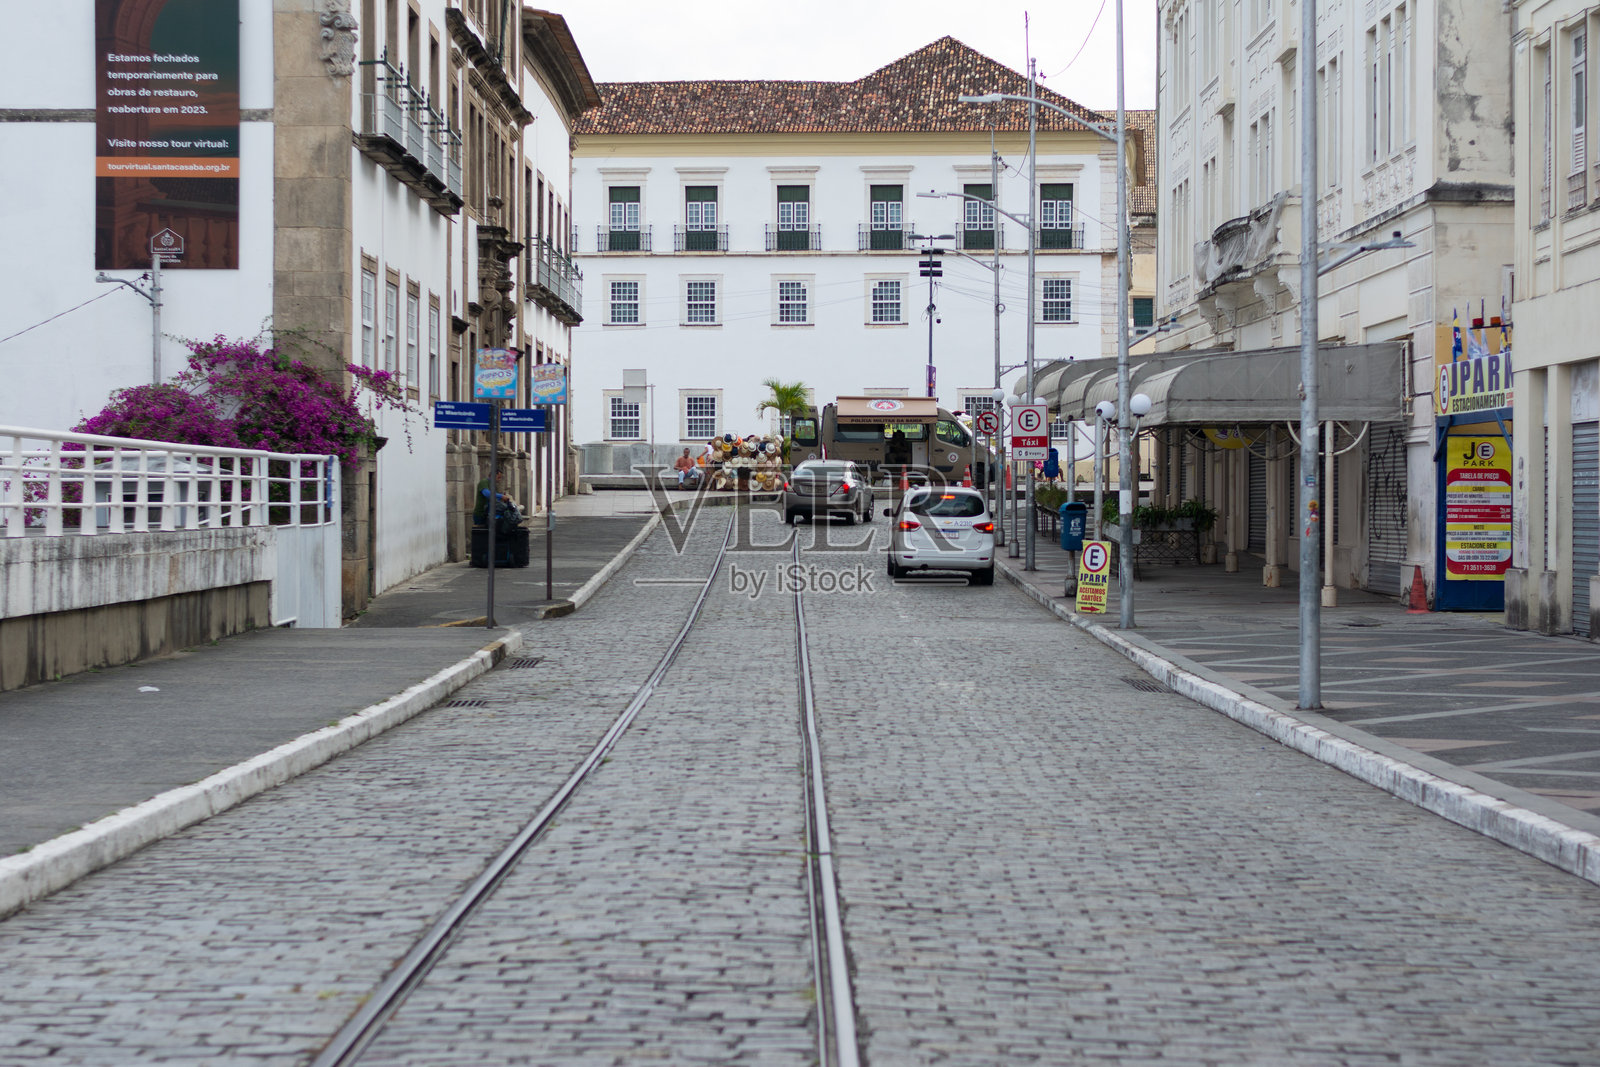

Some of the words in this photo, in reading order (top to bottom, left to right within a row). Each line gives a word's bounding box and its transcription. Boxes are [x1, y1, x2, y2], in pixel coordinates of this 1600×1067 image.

[108, 53, 151, 62] Estamos
[153, 54, 200, 63] fechados
[107, 71, 193, 80] temporariamente
[195, 73, 219, 81] para
[108, 88, 136, 96] obras
[138, 88, 151, 96] de
[153, 89, 198, 98] restauro,
[108, 105, 160, 113] reabertura
[181, 106, 208, 114] 2023.
[107, 139, 137, 148] Visite
[139, 140, 169, 148] nosso
[171, 140, 192, 148] tour
[194, 140, 229, 148] virtual:
[107, 164, 231, 172] tourvirtual.santacasaba.org.br
[1452, 392, 1506, 412] ESTACIONAMENTO
[1026, 414, 1034, 427] E
[1090, 548, 1100, 566] E
[1080, 573, 1107, 583] JPARK
[1080, 586, 1106, 595] ACEITAMOS
[1081, 594, 1102, 602] CARTÕES
